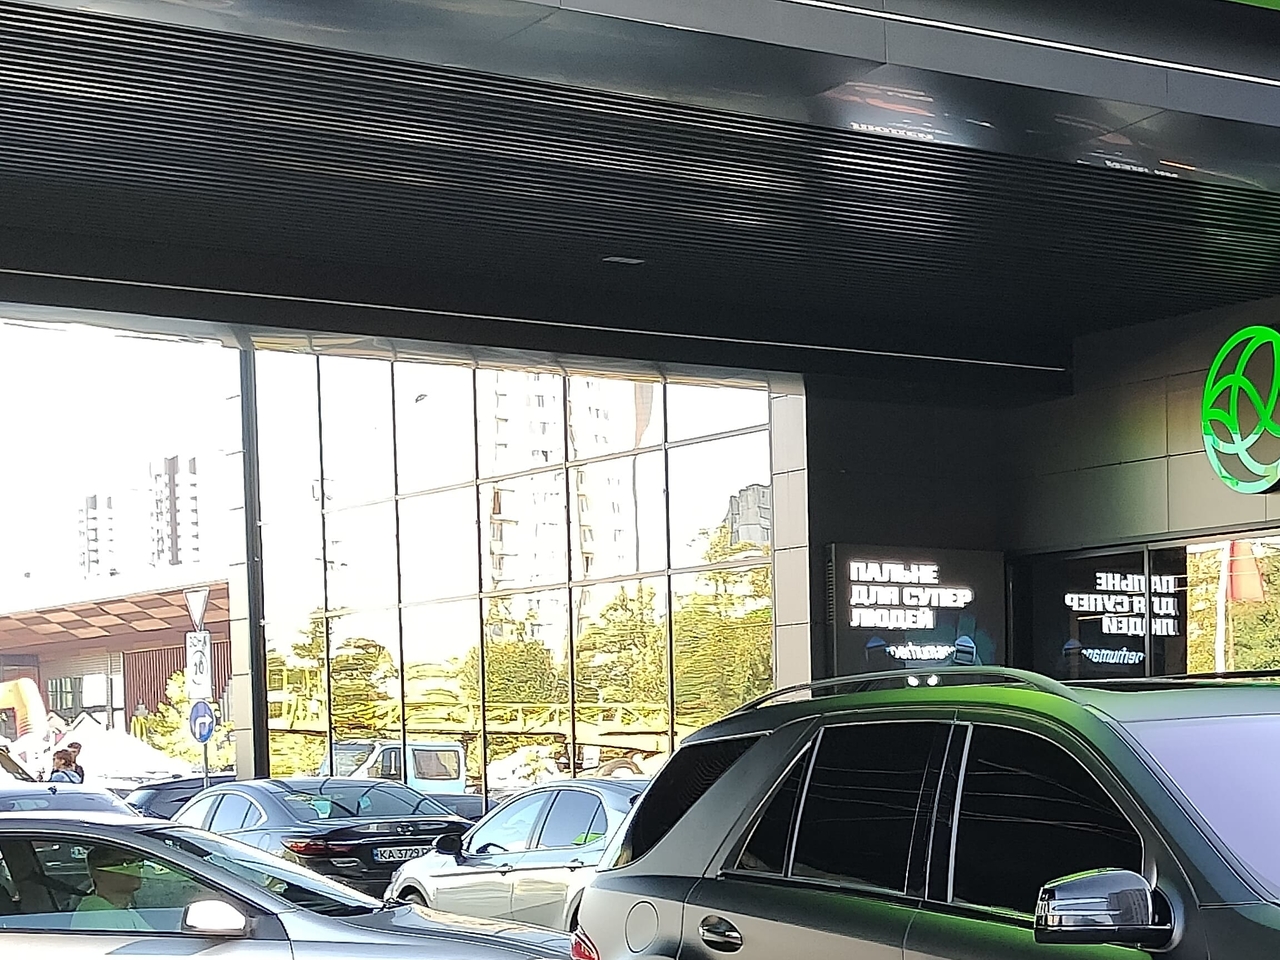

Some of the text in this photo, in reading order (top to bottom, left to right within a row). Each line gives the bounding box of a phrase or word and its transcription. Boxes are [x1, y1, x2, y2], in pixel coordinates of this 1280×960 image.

[850, 562, 939, 584] ПАЛЬНЕ
[850, 585, 972, 608] ДЛЯ СУПЕР
[850, 607, 934, 630] ЛЮДЕЙ
[380, 850, 396, 860] KA
[397, 848, 419, 859] 3729
